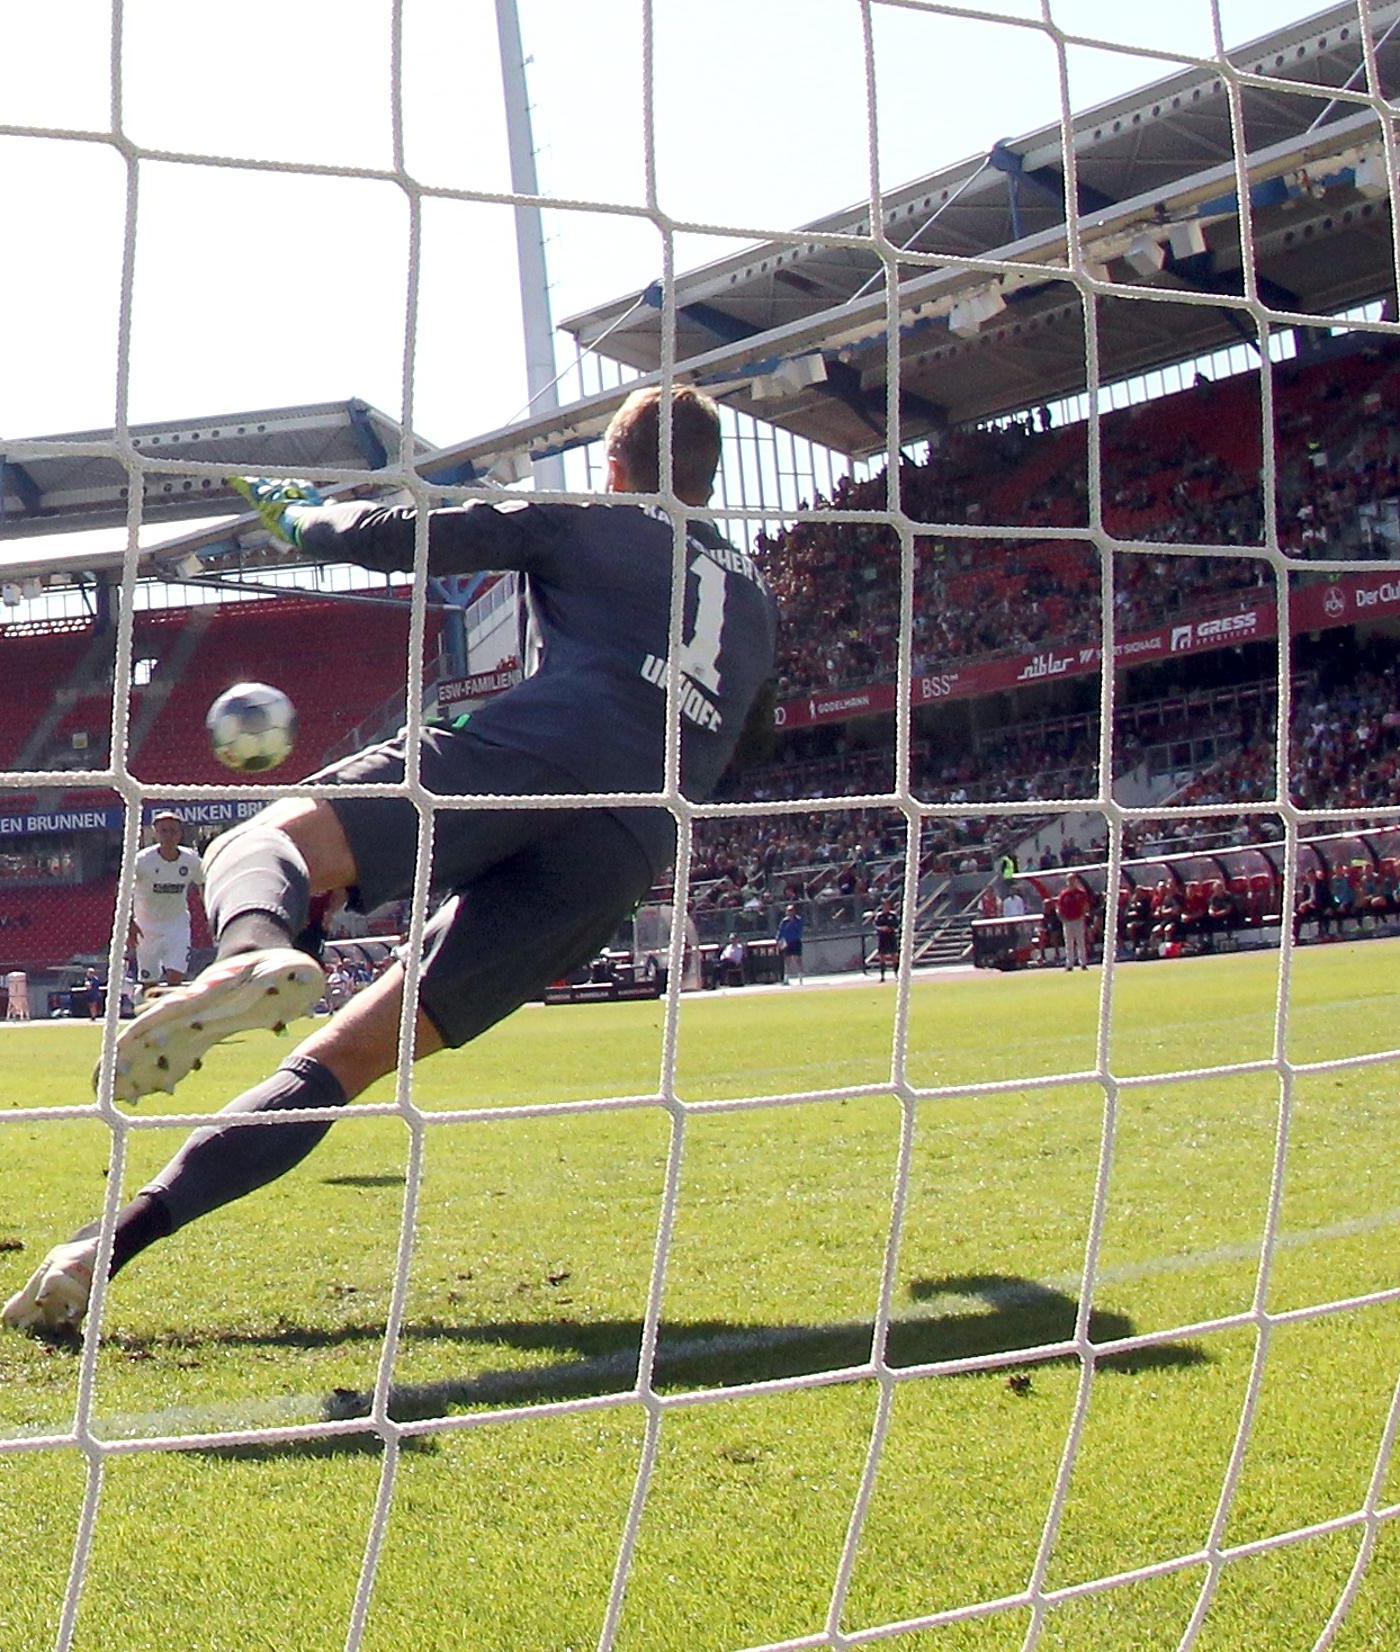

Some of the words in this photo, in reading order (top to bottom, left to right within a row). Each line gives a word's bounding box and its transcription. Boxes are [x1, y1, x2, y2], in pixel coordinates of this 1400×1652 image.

[1356, 590, 1378, 607] Der
[1380, 580, 1400, 602] Clu
[678, 553, 727, 696] 1
[1197, 612, 1257, 636] GRESS
[27, 812, 107, 833] BRUNNEN
